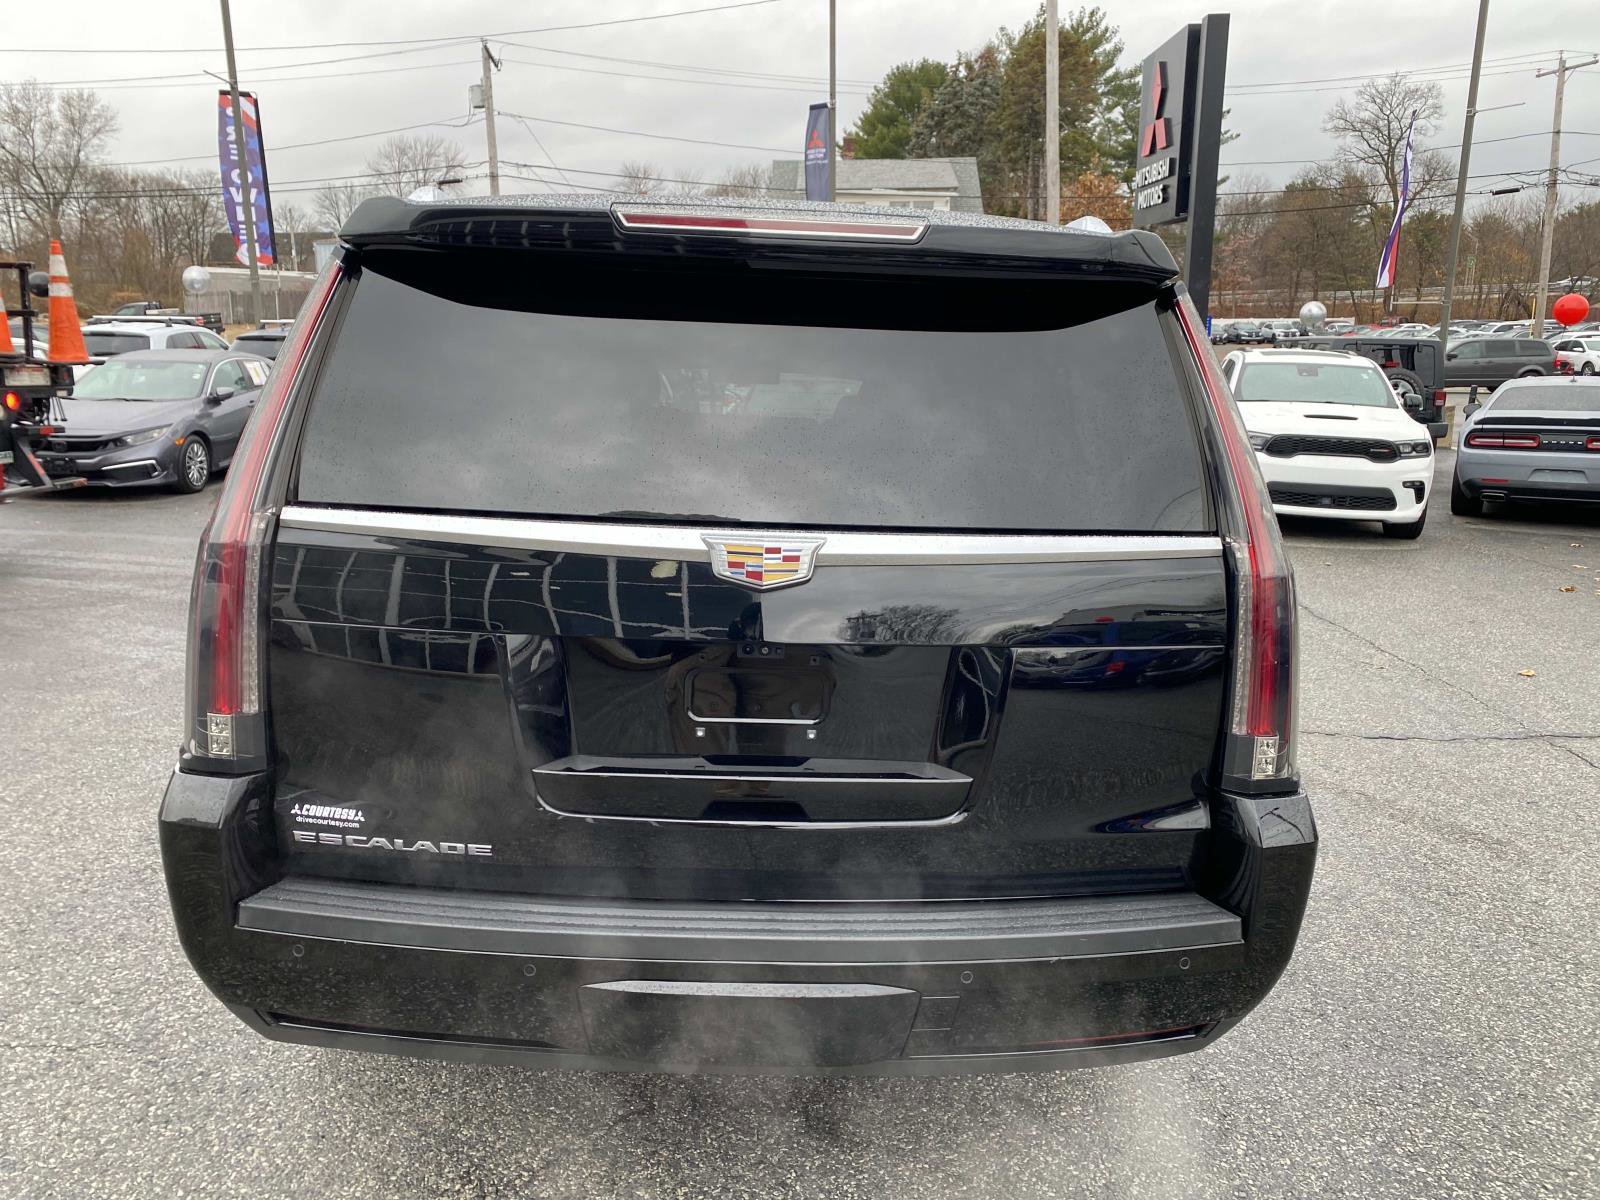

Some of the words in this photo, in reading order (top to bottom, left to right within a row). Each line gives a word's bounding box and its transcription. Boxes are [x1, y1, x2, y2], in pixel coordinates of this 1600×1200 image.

[1137, 184, 1163, 210] MOTORS
[295, 815, 360, 828] drivecourtesy.com
[292, 830, 493, 856] ESCALADE
